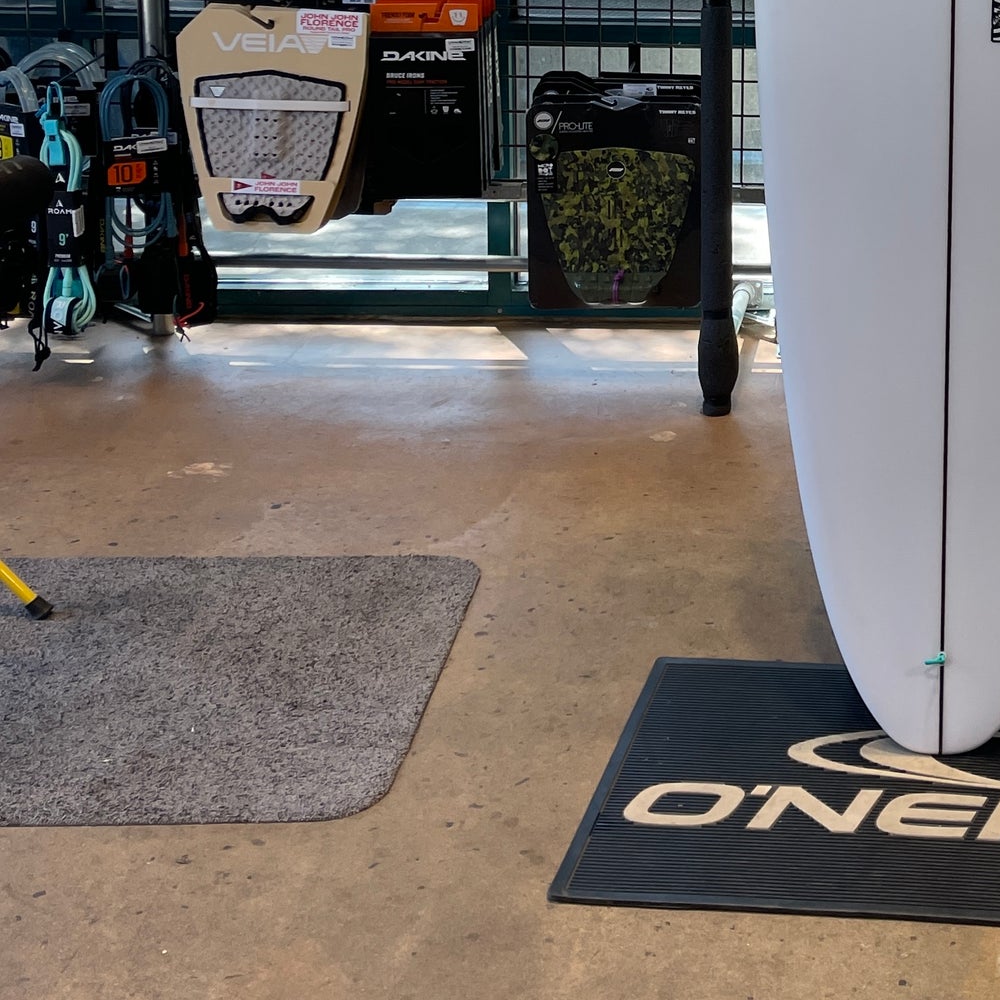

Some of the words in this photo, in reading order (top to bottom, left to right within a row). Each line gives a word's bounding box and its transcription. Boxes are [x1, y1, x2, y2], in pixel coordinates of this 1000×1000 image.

[300, 13, 328, 21] JOHN
[329, 13, 359, 21] JOHN
[300, 19, 359, 28] FLORENCE
[212, 31, 307, 54] VEIA
[380, 51, 467, 61] DAKINE
[113, 164, 133, 183] 10
